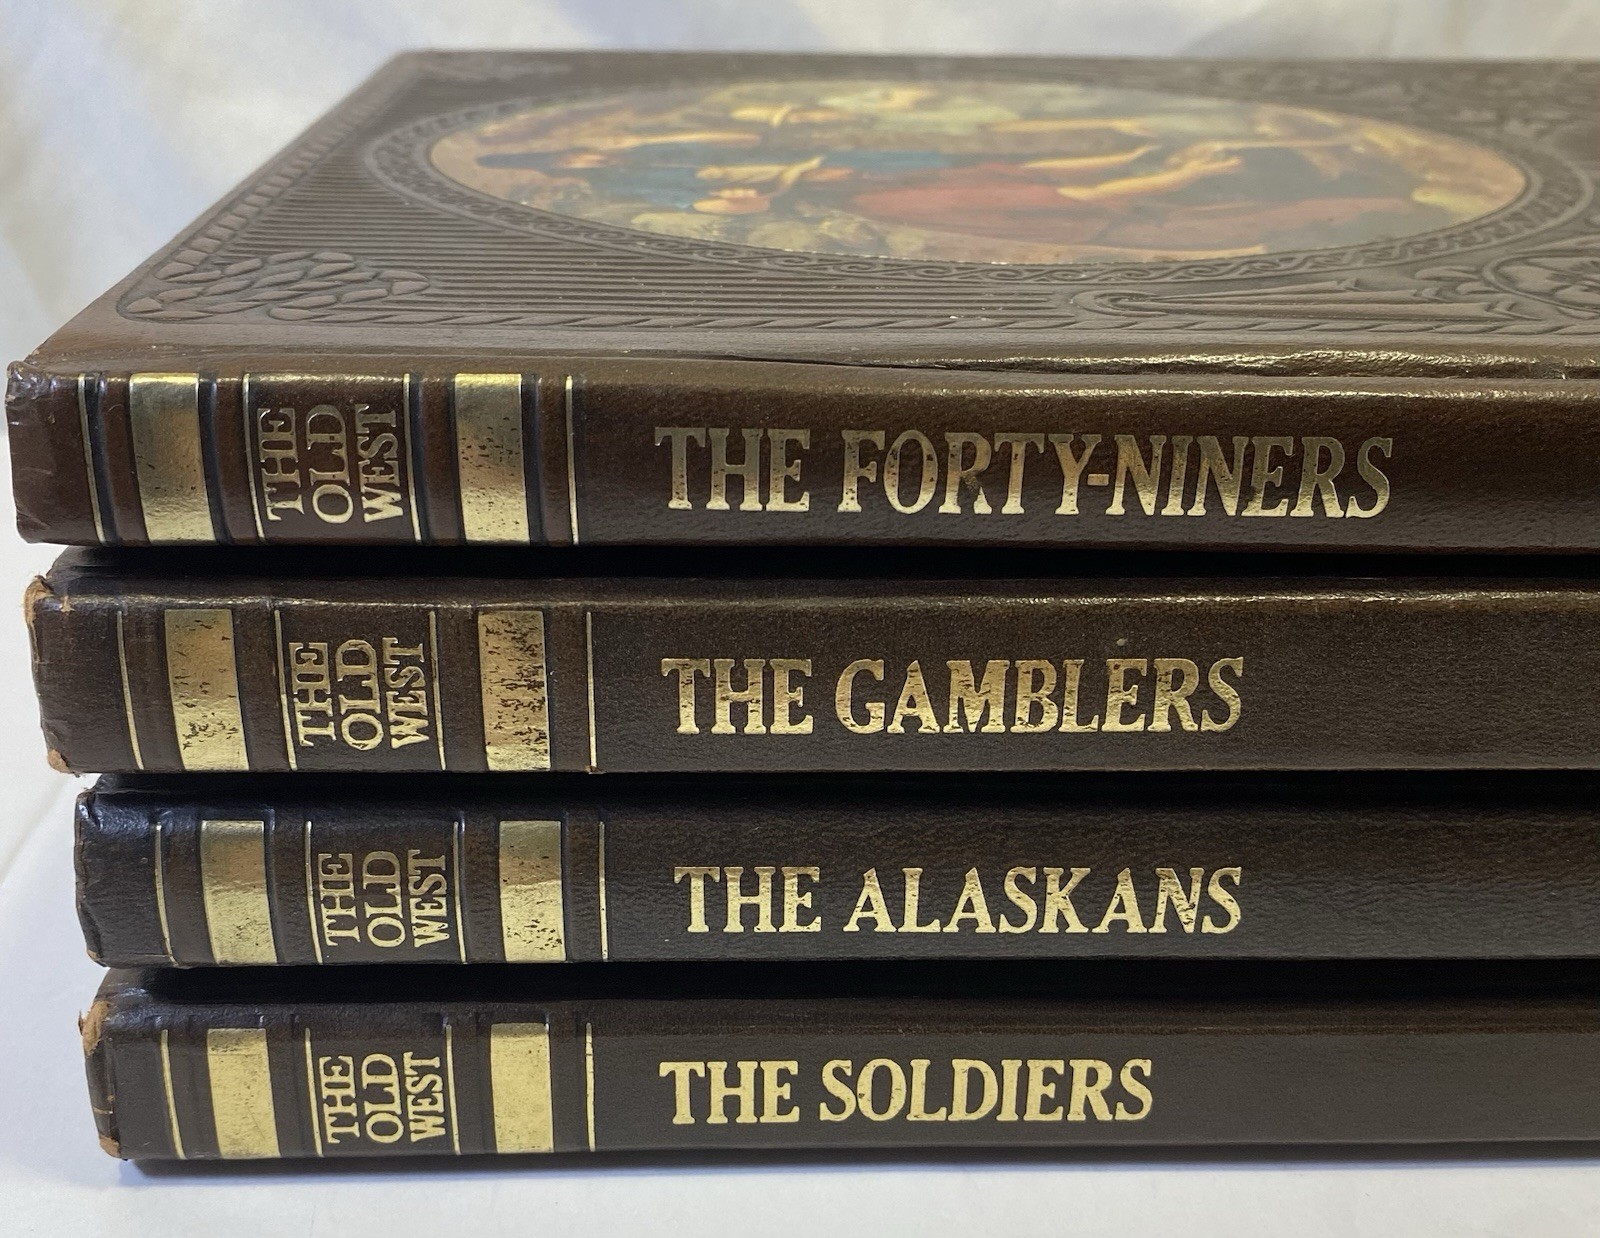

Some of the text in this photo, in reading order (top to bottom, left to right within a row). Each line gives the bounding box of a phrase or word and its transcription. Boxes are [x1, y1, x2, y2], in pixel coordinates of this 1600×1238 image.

[257, 407, 304, 521] THE
[306, 404, 354, 524] OLD
[355, 403, 403, 523] WEST
[655, 427, 1394, 519] THE FORTY-NINERS
[289, 642, 337, 747] THE
[336, 639, 384, 750] OLD
[382, 637, 430, 749] WEST
[661, 656, 1244, 736] THE GAMBLERS
[318, 853, 361, 946] THE
[362, 851, 406, 947] OLD
[407, 849, 449, 947] WEST
[674, 866, 1243, 935] THE ALASKANS
[319, 1056, 361, 1144] THE
[361, 1053, 404, 1143] OLD
[403, 1051, 446, 1142] WEST
[659, 1058, 1153, 1125] THE SOLDIERS
